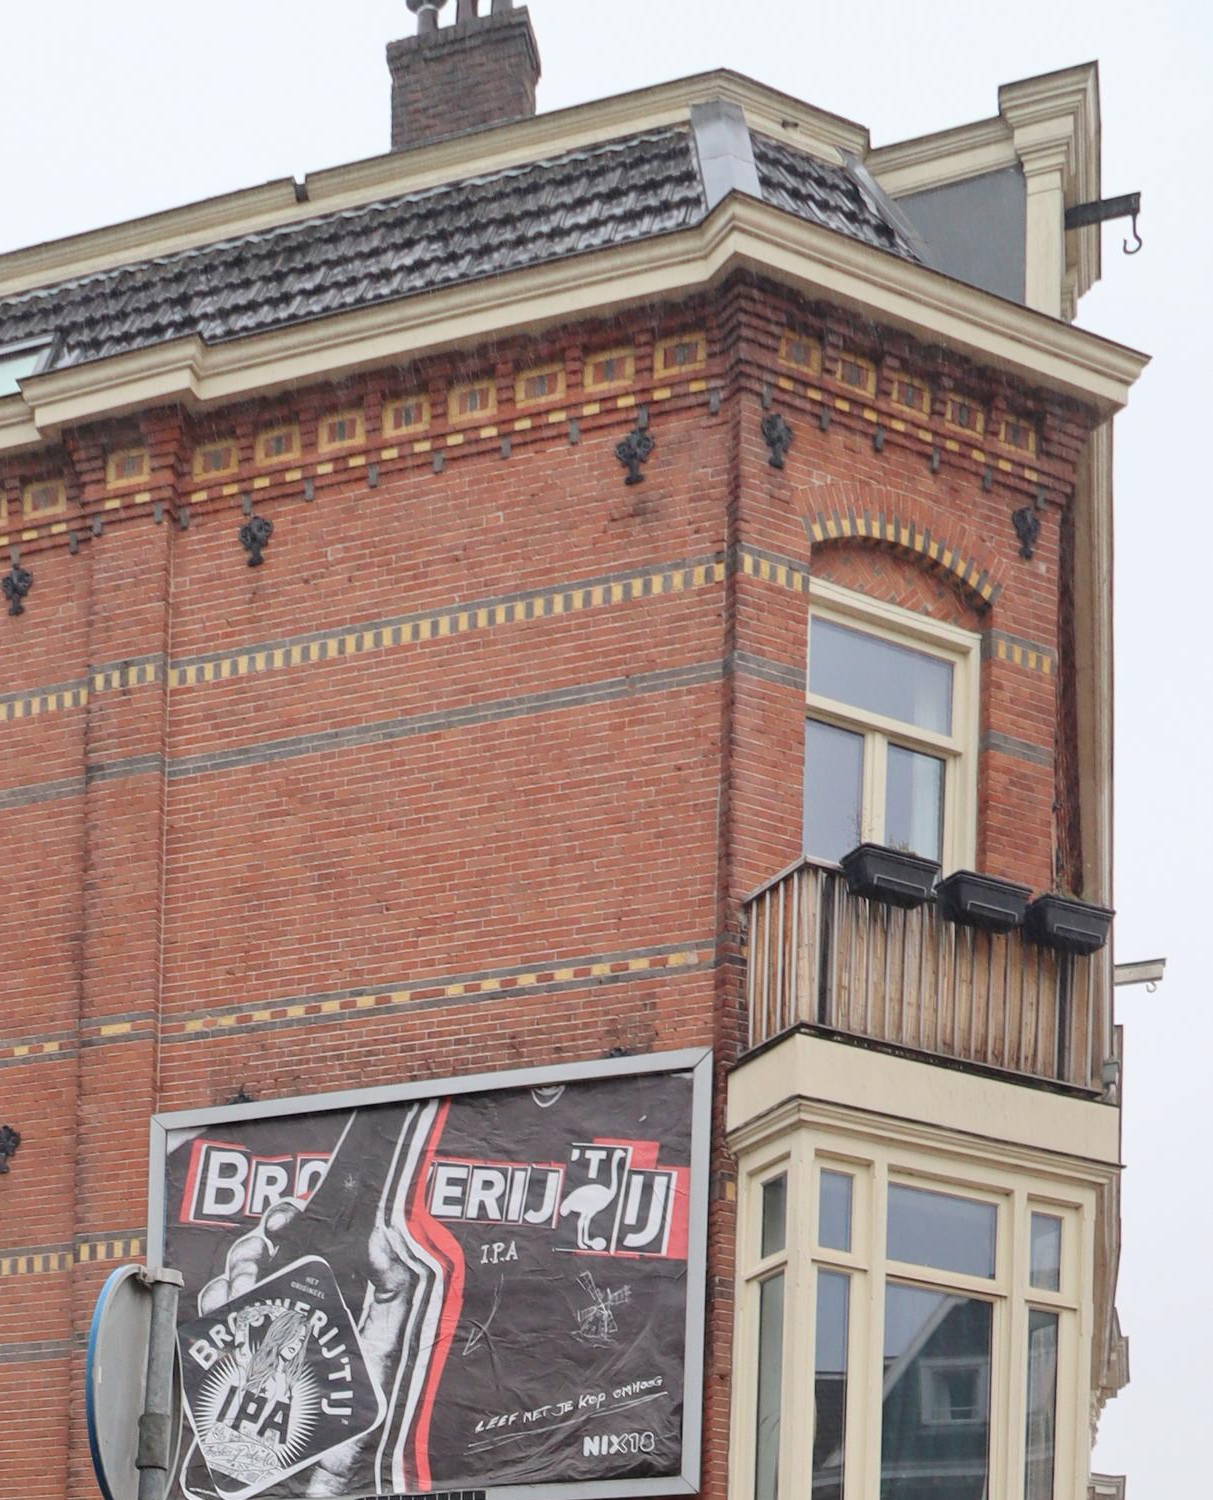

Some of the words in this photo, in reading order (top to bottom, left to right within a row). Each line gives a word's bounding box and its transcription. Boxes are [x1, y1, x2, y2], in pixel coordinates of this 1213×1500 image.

[622, 1174, 668, 1248] IJ
[215, 1384, 292, 1444] IPA
[475, 1412, 519, 1433] LEEF
[523, 1405, 552, 1424] MET
[551, 1400, 573, 1416] JE
[578, 1392, 606, 1410] KOP
[612, 1375, 663, 1399] OMHOOG
[582, 1431, 655, 1457] NIX18
